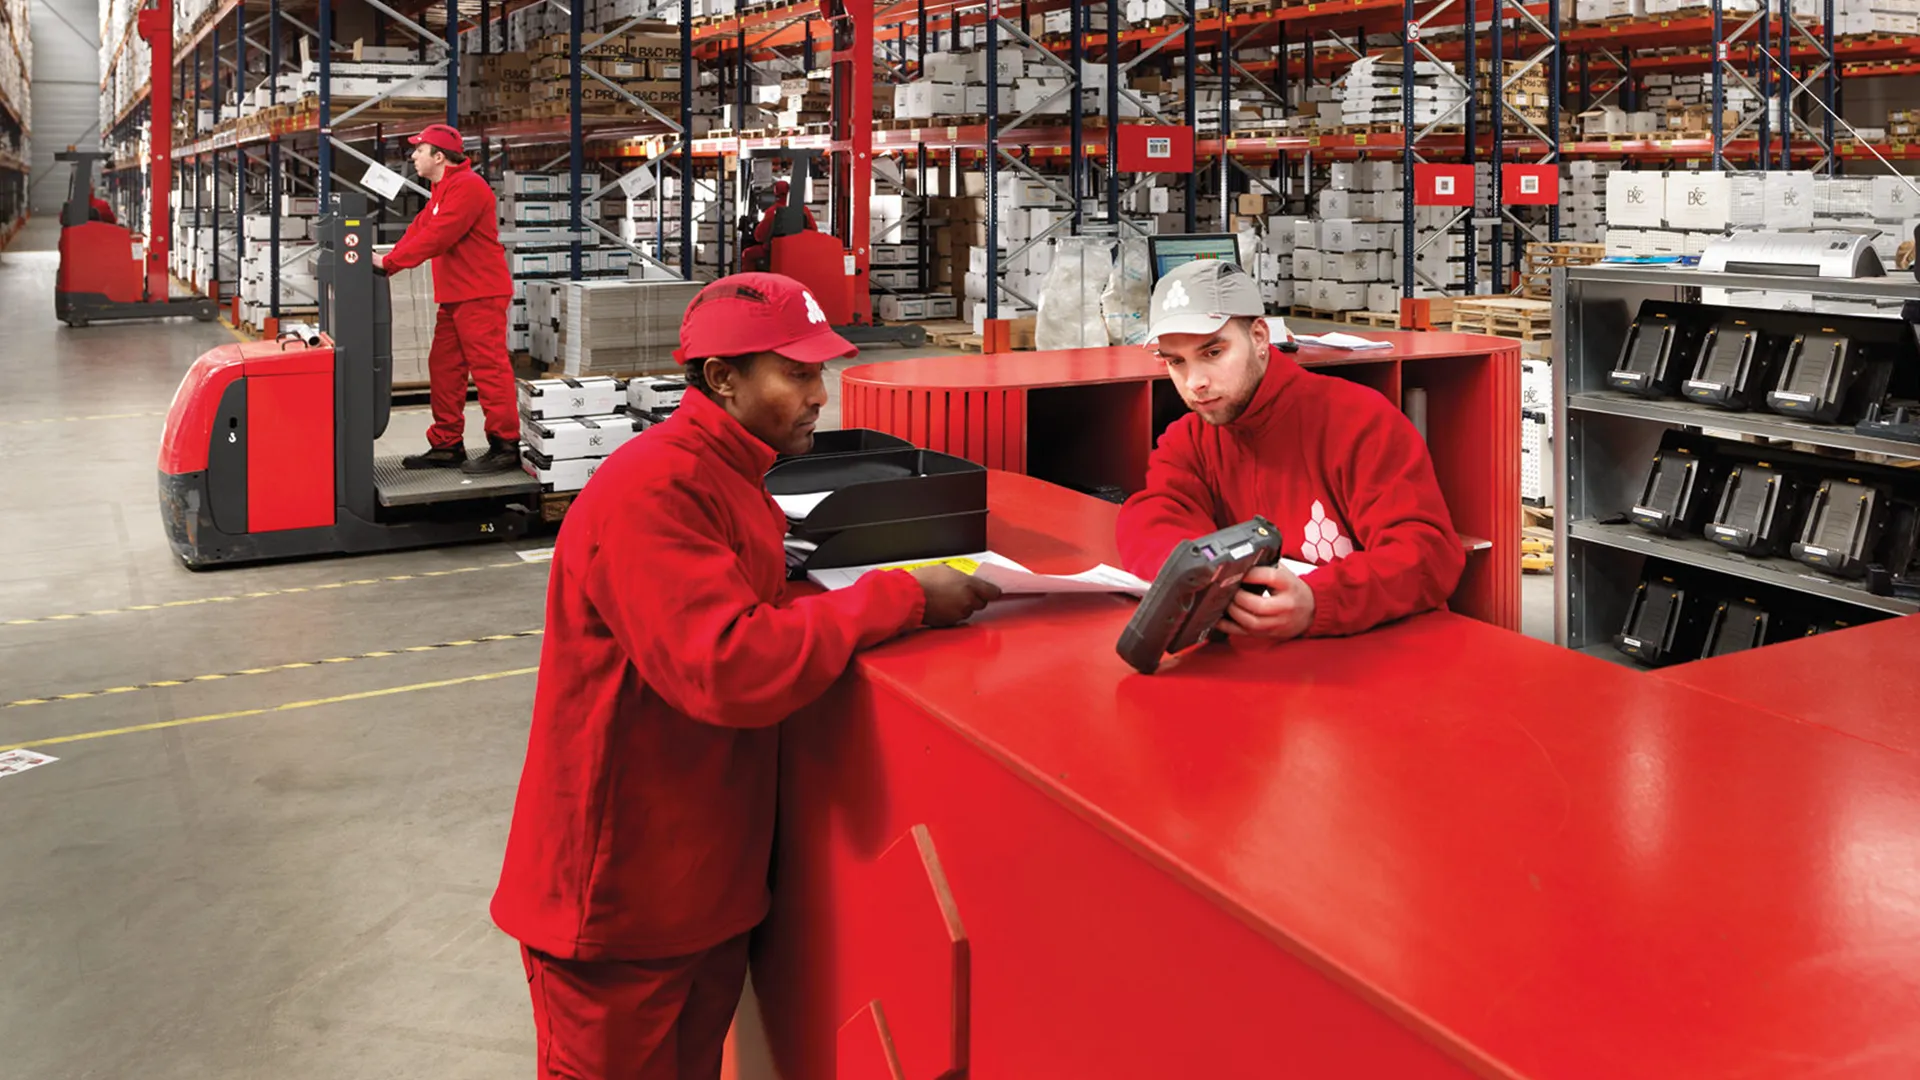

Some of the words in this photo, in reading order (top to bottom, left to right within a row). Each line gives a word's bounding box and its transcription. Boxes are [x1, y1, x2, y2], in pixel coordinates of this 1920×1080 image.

[1409, 23, 1419, 39] G
[638, 46, 662, 58] B&C
[1627, 186, 1645, 204] B&C
[1687, 187, 1707, 206] B&C
[1523, 386, 1539, 404] B&C
